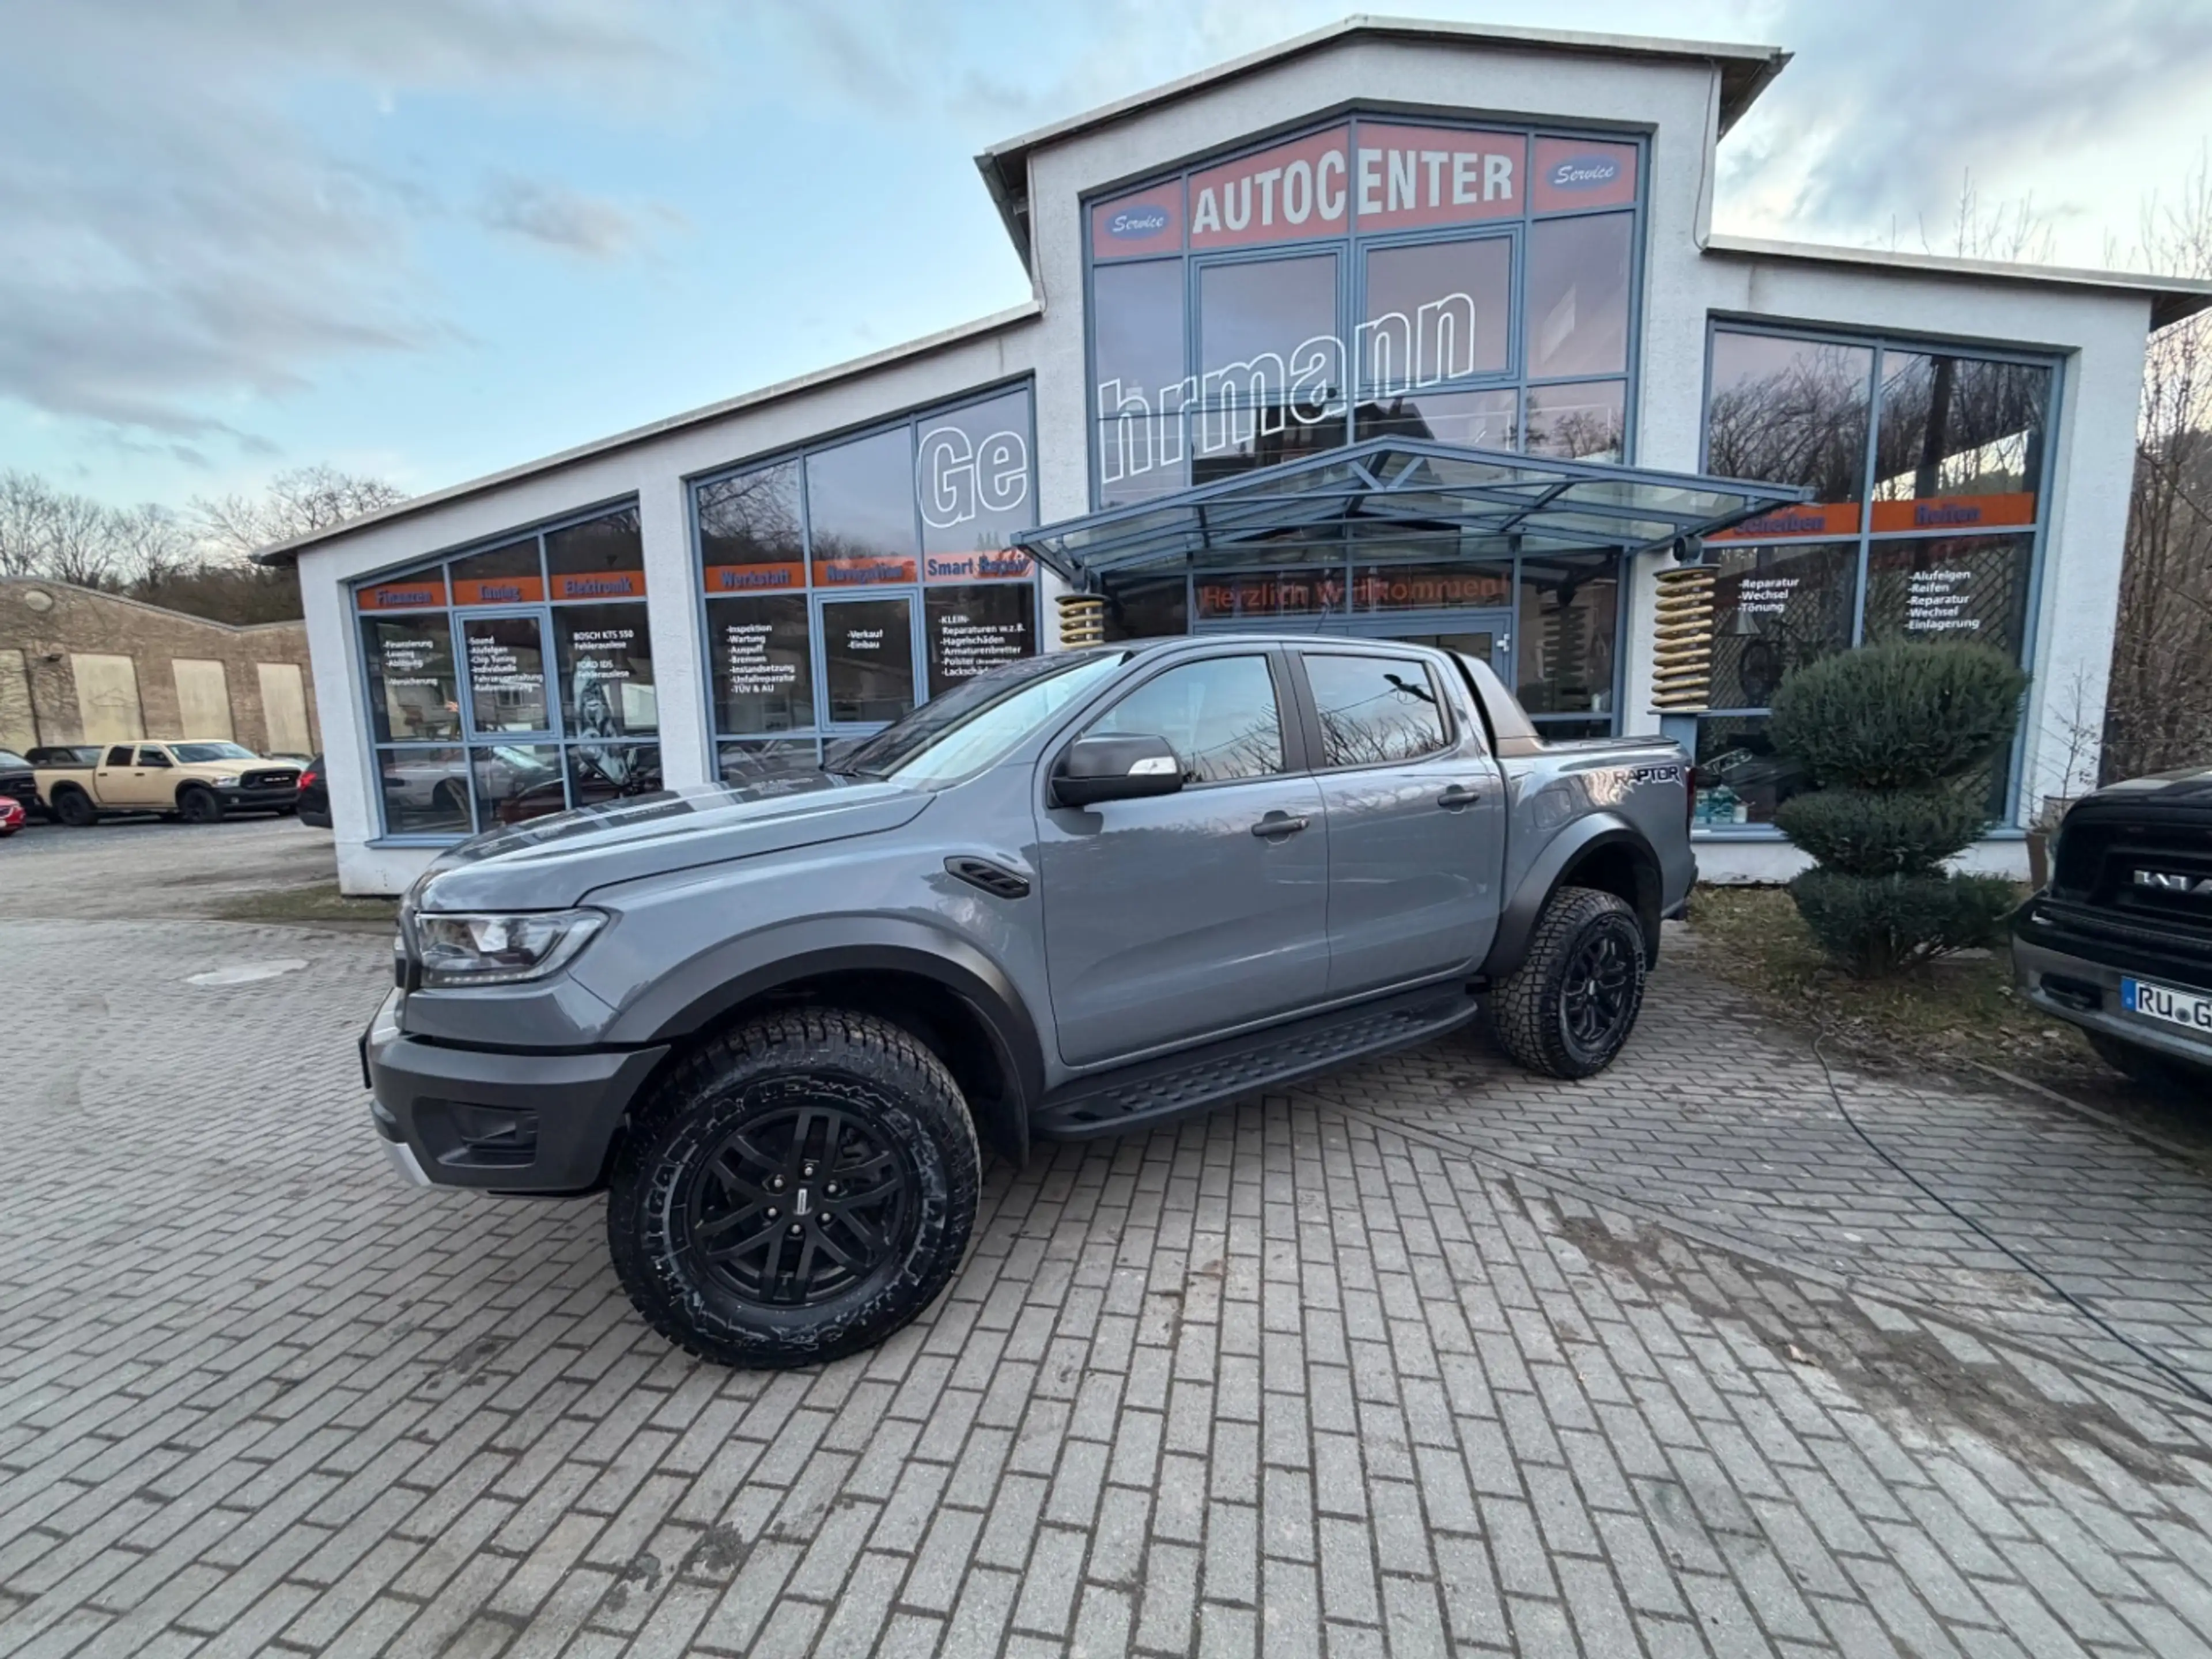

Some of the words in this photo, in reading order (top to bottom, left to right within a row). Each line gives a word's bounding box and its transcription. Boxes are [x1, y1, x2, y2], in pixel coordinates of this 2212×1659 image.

[1553, 165, 1613, 184] Service
[1192, 148, 1513, 233] AUTOCENTER
[1112, 214, 1164, 233] Service
[927, 558, 974, 577] Smart
[565, 576, 632, 595] Elektronik
[720, 568, 789, 587] Werkstatt
[1202, 580, 1307, 608] Herzlich
[573, 631, 600, 641] BOSCH
[942, 626, 997, 636] Reparaturen
[1613, 766, 1684, 787] RAPTOR
[2138, 986, 2172, 1018] RU
